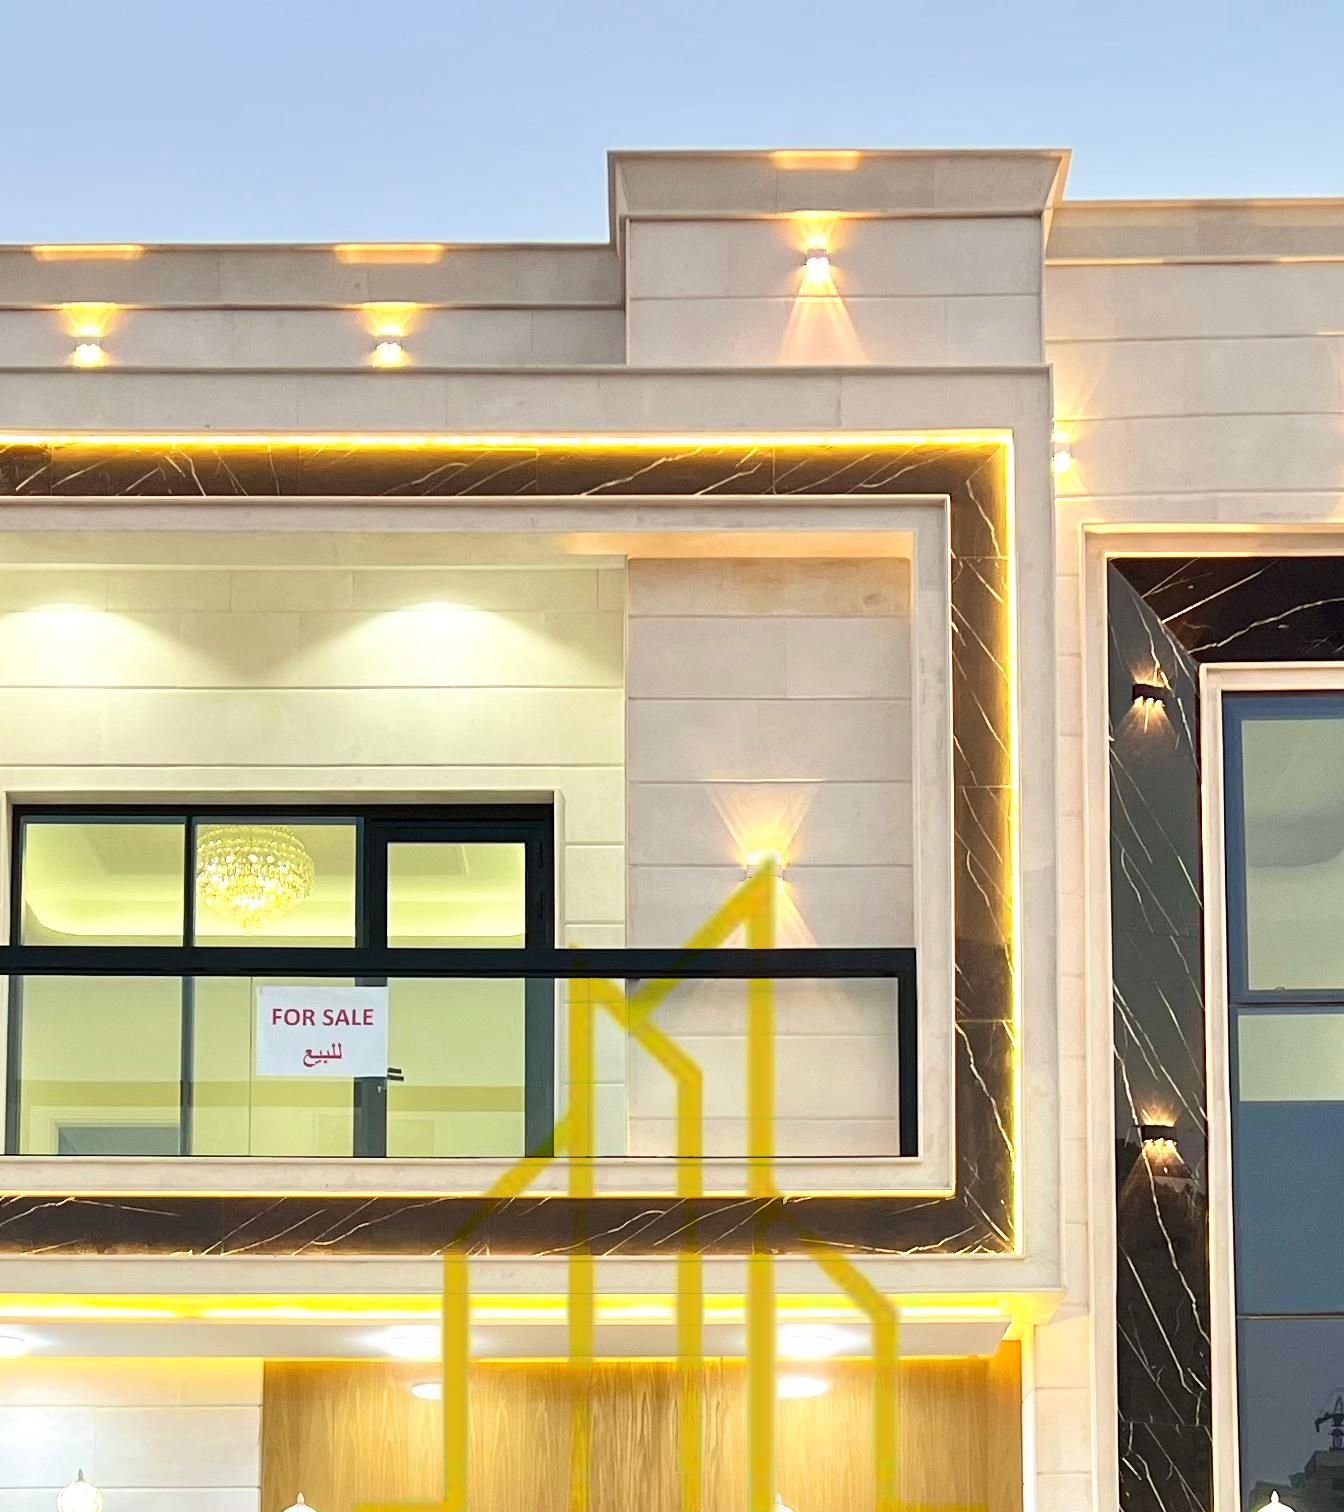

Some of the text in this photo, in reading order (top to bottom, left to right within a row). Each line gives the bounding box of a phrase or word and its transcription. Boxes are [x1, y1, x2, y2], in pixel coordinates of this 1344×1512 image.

[272, 1008, 374, 1026] FOR SALE
[303, 1042, 342, 1067] للبيع
